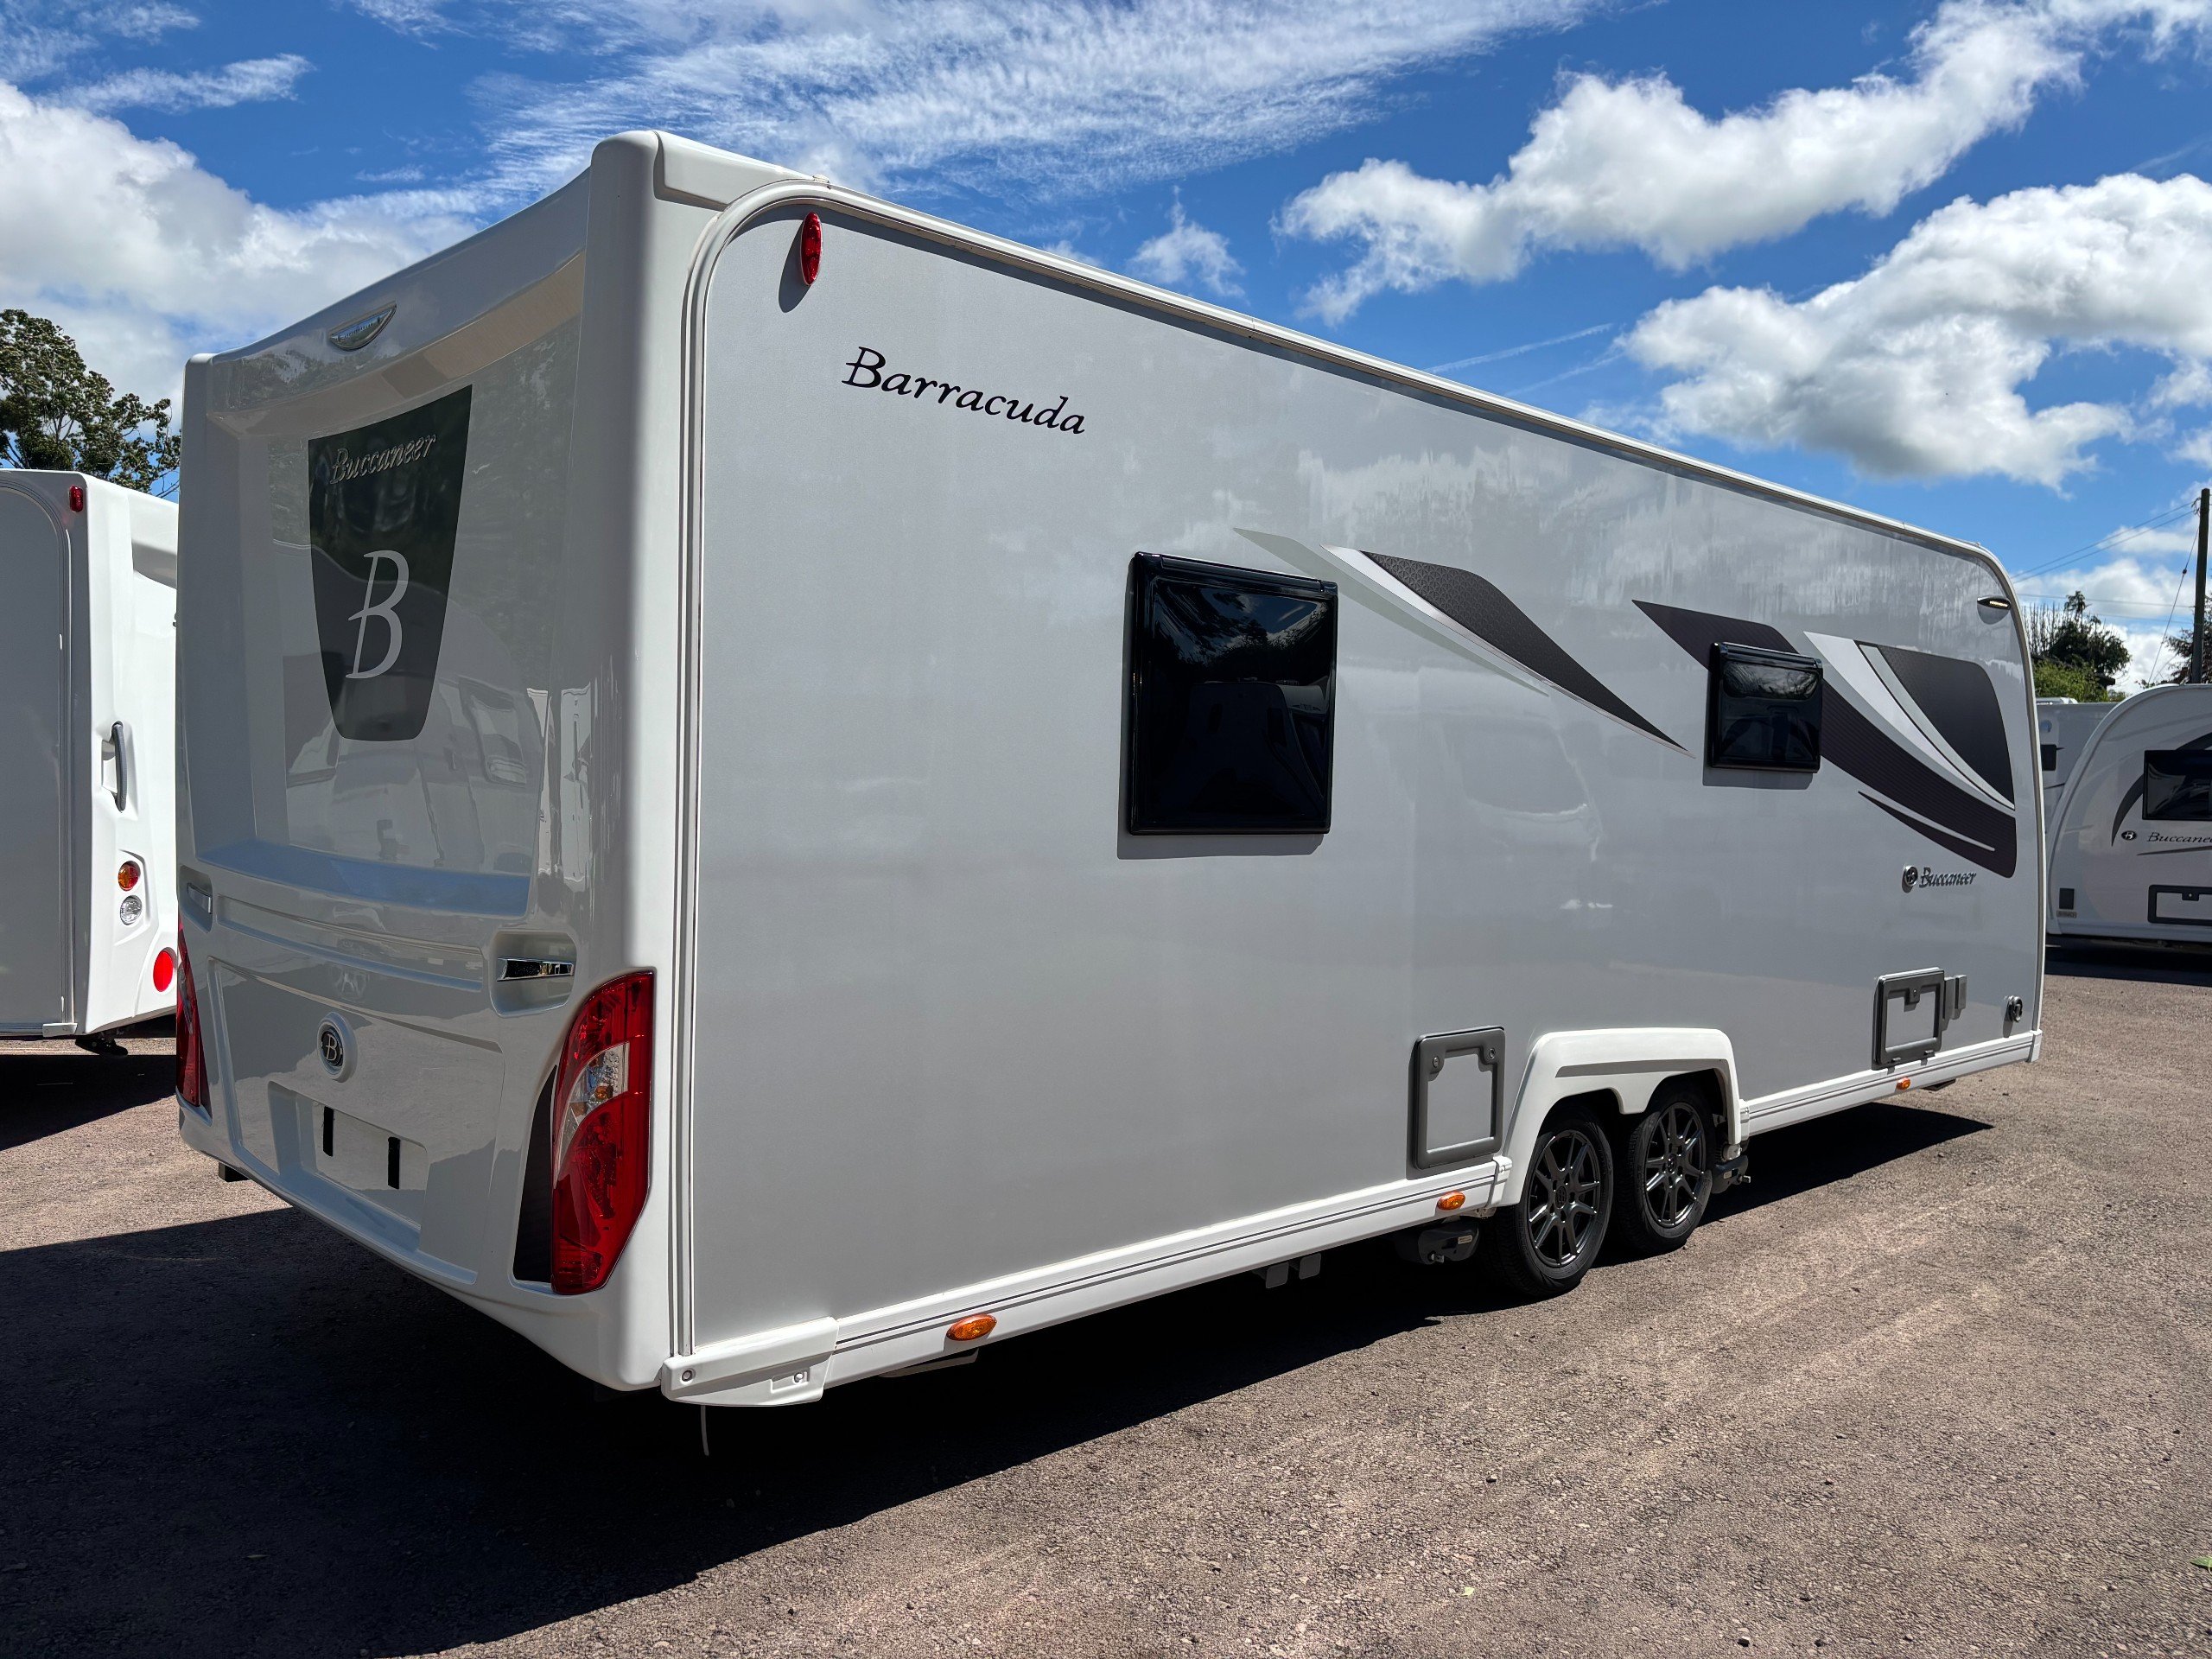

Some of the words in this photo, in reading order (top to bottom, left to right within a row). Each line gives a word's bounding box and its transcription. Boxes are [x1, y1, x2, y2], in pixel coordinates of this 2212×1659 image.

[841, 346, 1085, 435] Barracuda
[329, 434, 437, 485] Buccaneer
[346, 550, 410, 679] B
[1918, 867, 1977, 888] Buccaneer
[325, 1033, 338, 1061] B
